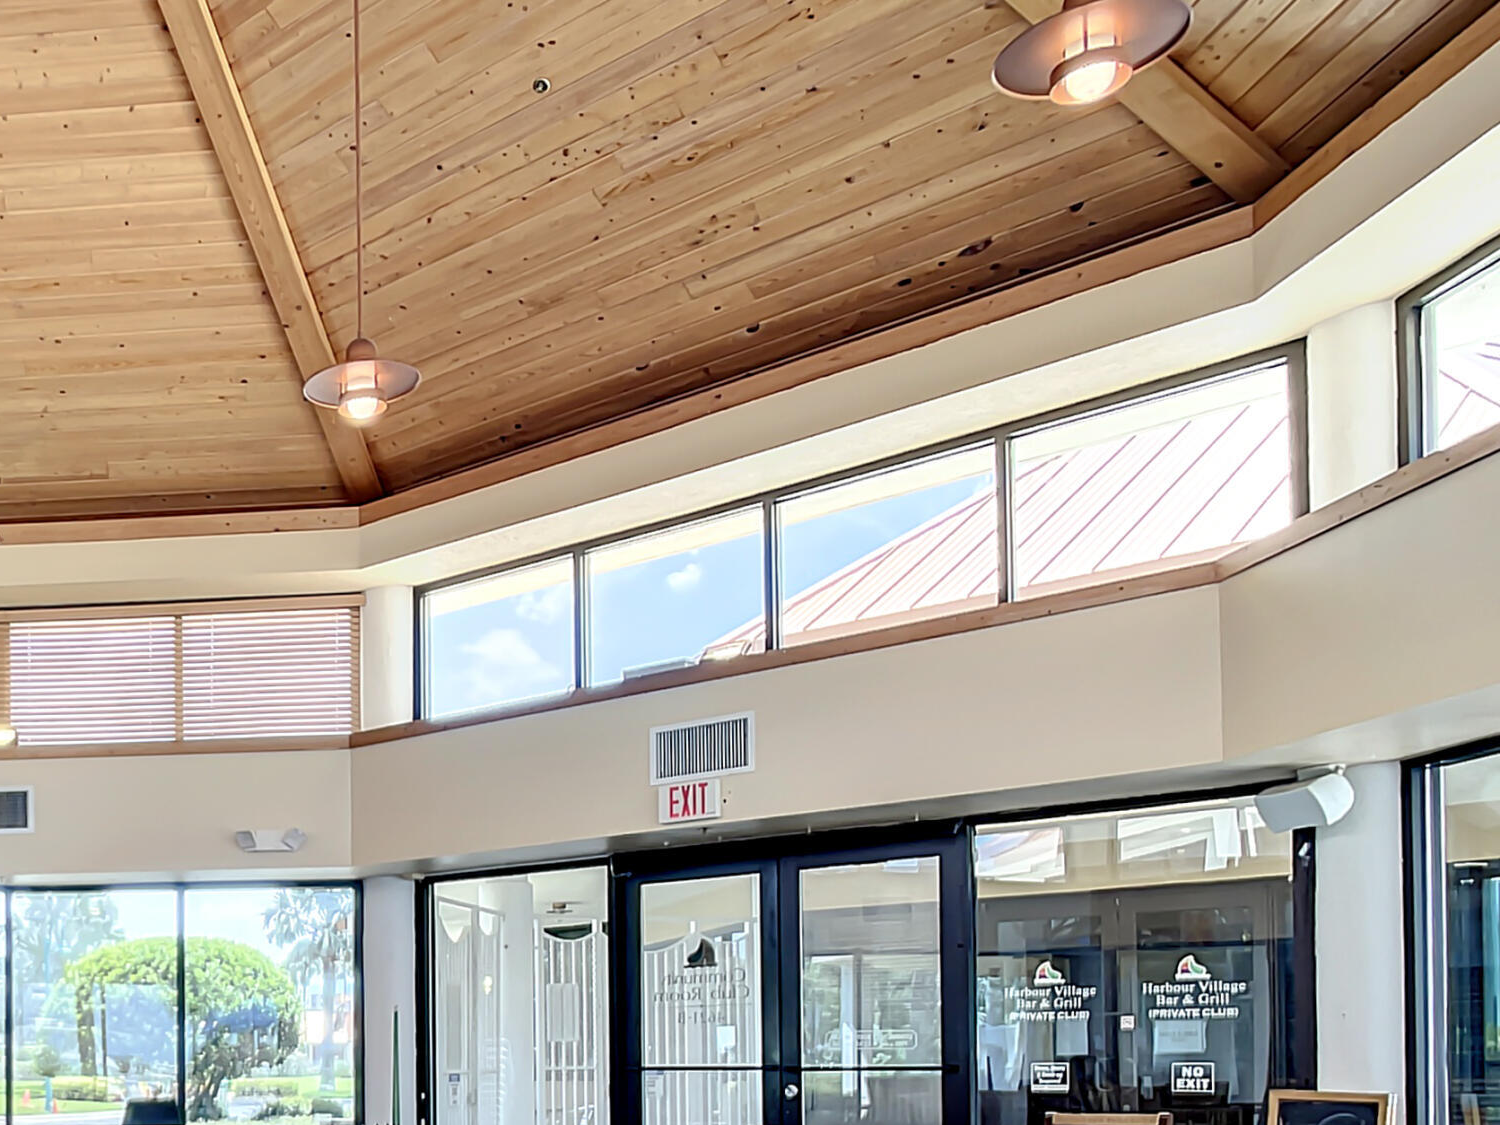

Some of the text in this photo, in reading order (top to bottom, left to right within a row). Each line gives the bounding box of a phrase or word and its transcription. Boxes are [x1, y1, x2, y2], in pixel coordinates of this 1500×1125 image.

[669, 782, 708, 818] EXIT
[1004, 985, 1097, 999] Harbour Village
[1142, 981, 1247, 995] Harbour Village
[1017, 997, 1082, 1010] Bar & Grill
[1156, 992, 1230, 1007] Bar & Grill
[1148, 1007, 1239, 1019] (PRIVATE CLUB)
[1182, 1066, 1204, 1078] NO
[1176, 1078, 1211, 1090] EXIT
